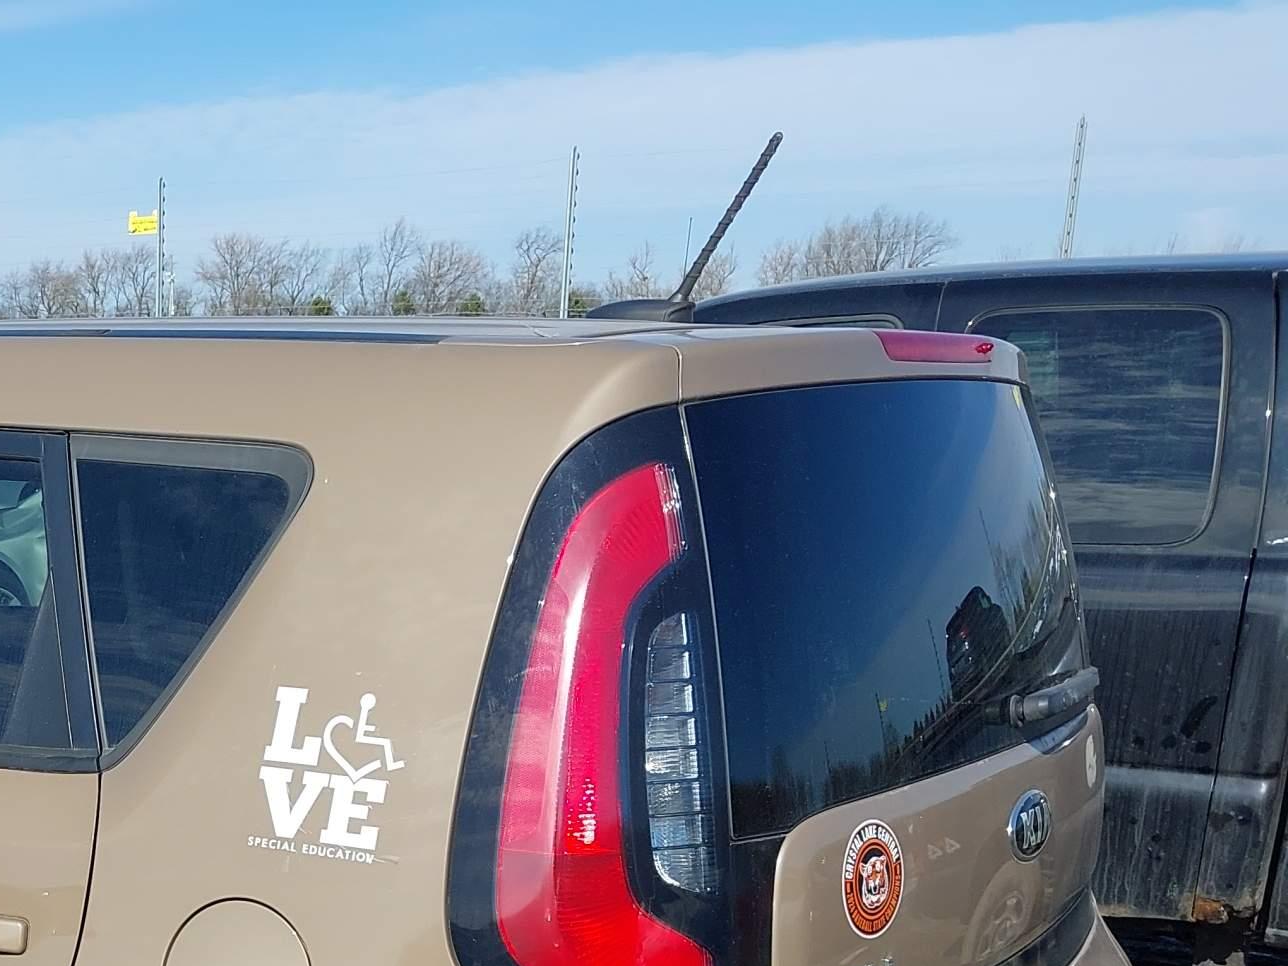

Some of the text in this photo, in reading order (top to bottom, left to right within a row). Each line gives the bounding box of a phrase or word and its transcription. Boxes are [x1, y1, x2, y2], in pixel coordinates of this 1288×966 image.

[247, 835, 376, 865] SPECIAL EDUCATION
[845, 825, 900, 880] CRYSTAL LAKE CENTRAL
